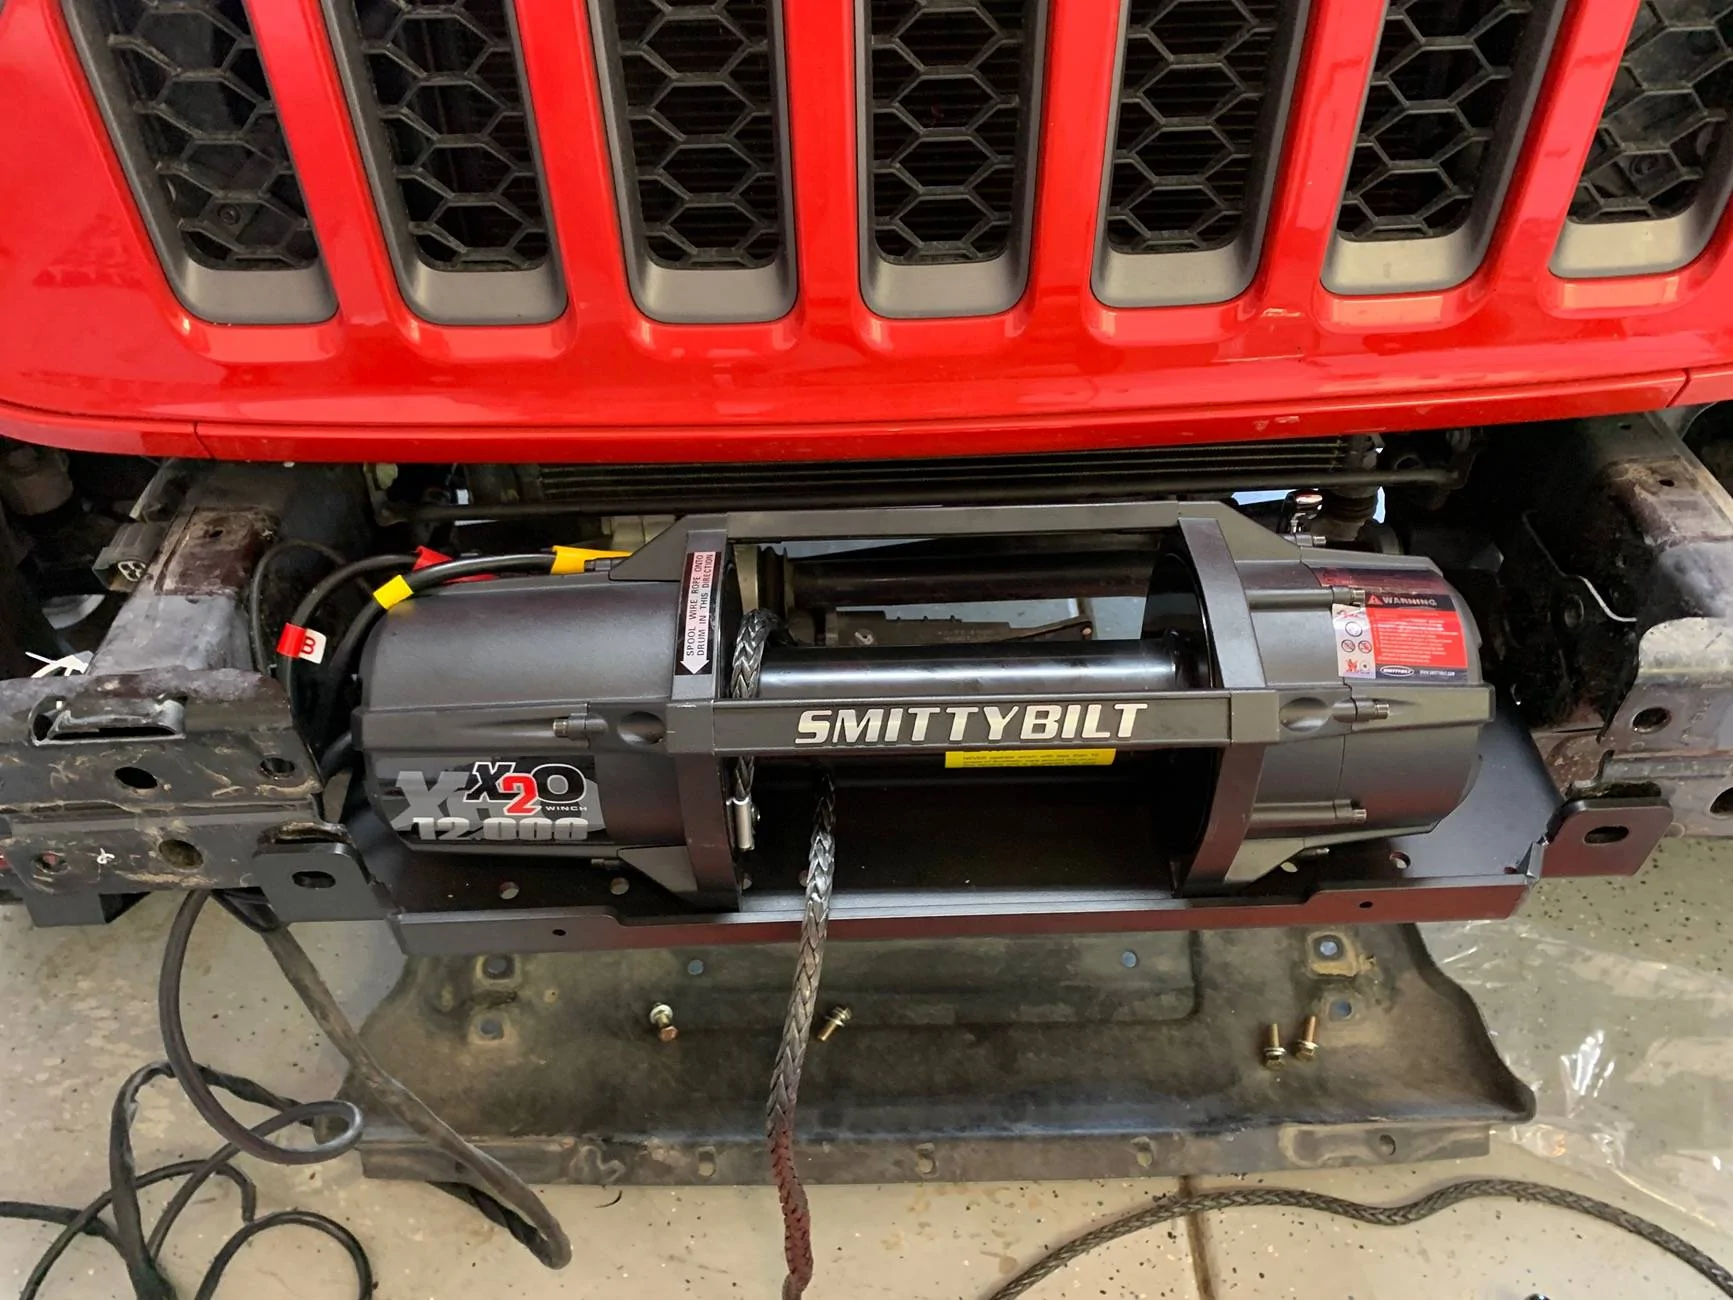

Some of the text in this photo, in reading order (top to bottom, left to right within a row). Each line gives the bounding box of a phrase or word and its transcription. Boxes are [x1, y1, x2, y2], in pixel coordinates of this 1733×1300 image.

[686, 554, 704, 656] SPOOL WIRE ROPE ONTO
[697, 553, 714, 656] DRUM IN THIS DIRECTION
[1382, 596, 1438, 606] WARNING
[795, 703, 1148, 744] SMITTYBILT
